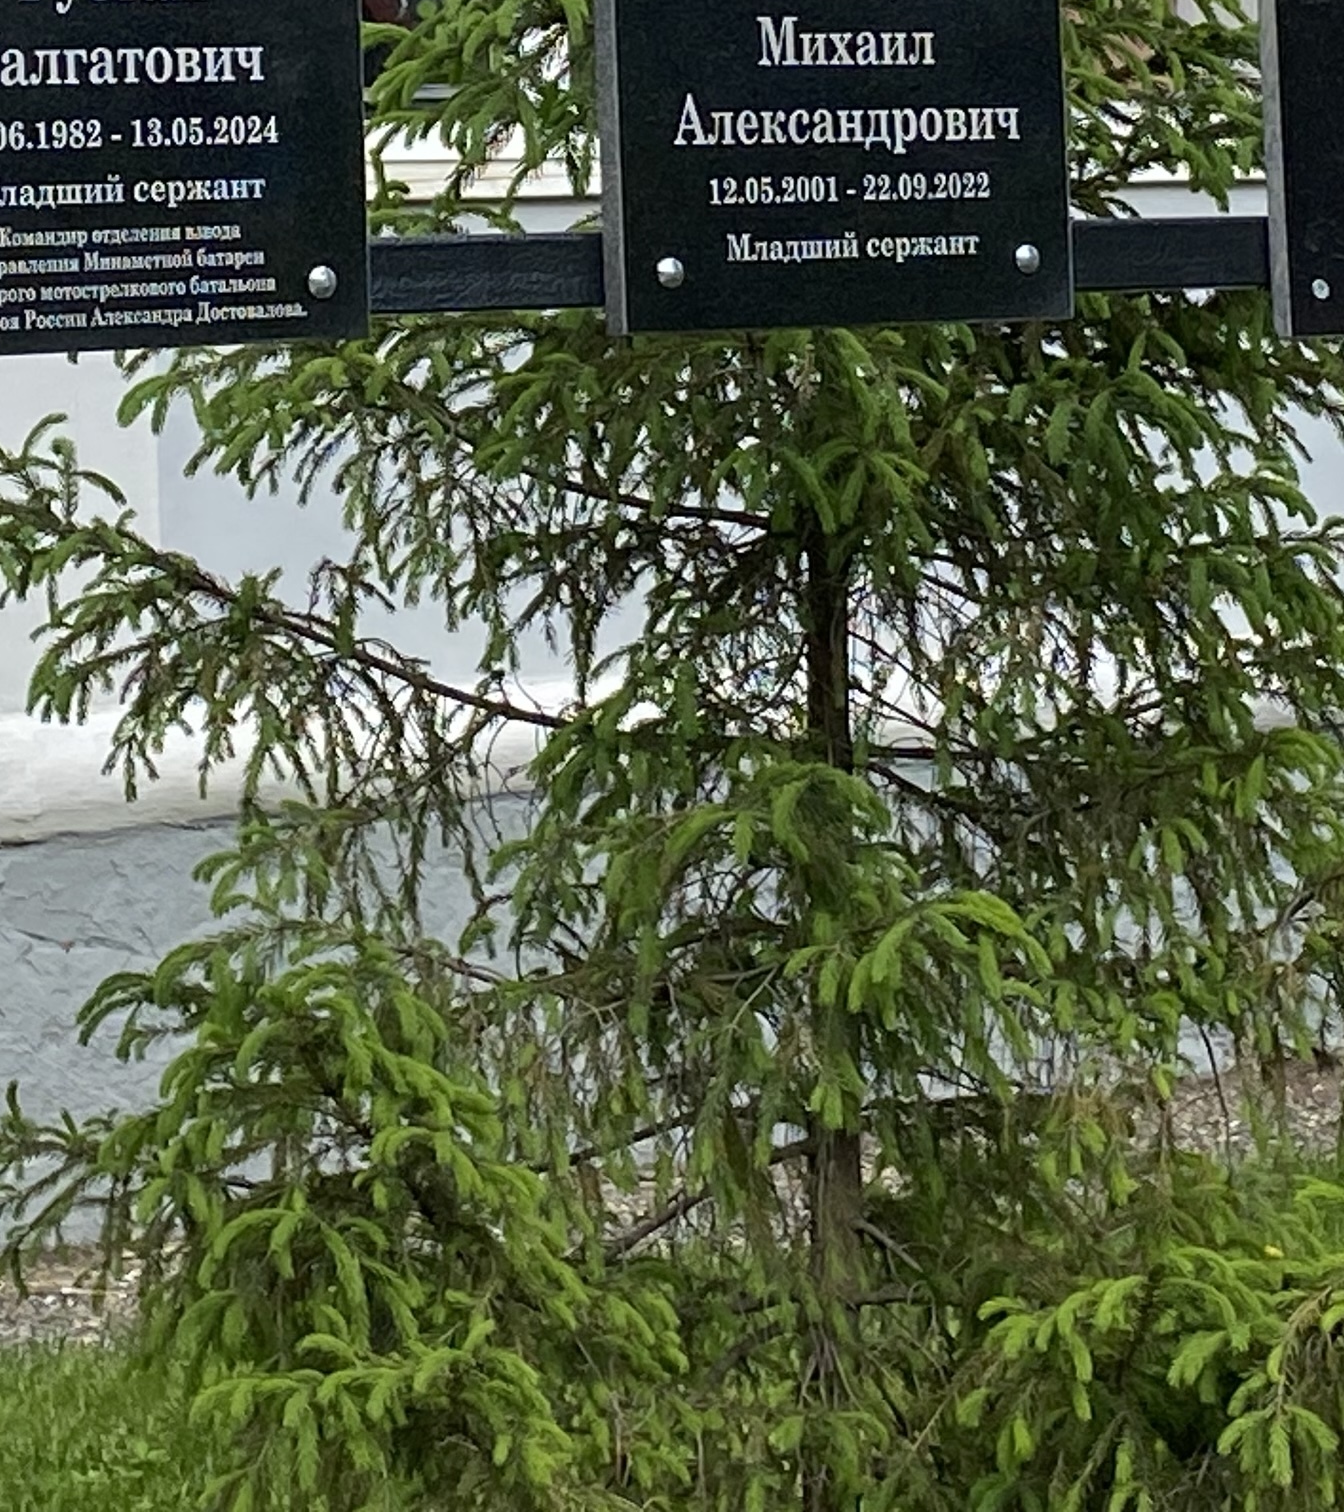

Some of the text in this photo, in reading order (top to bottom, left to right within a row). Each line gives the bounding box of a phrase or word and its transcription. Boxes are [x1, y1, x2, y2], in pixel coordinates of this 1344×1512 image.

[756, 16, 936, 67] Михаил
[130, 115, 279, 147] 13.05.2024
[673, 92, 1021, 155] Александрович
[133, 178, 266, 208] сержант
[709, 175, 839, 206] 12.05.2001
[863, 171, 991, 201] 22.09.2022
[91, 226, 181, 245] отделения
[726, 231, 980, 264] Младший сержант
[196, 247, 265, 270] батареи
[40, 281, 187, 303] мотострелкового
[189, 274, 276, 295] батальона
[23, 309, 88, 330] России
[90, 307, 193, 328] Александра
